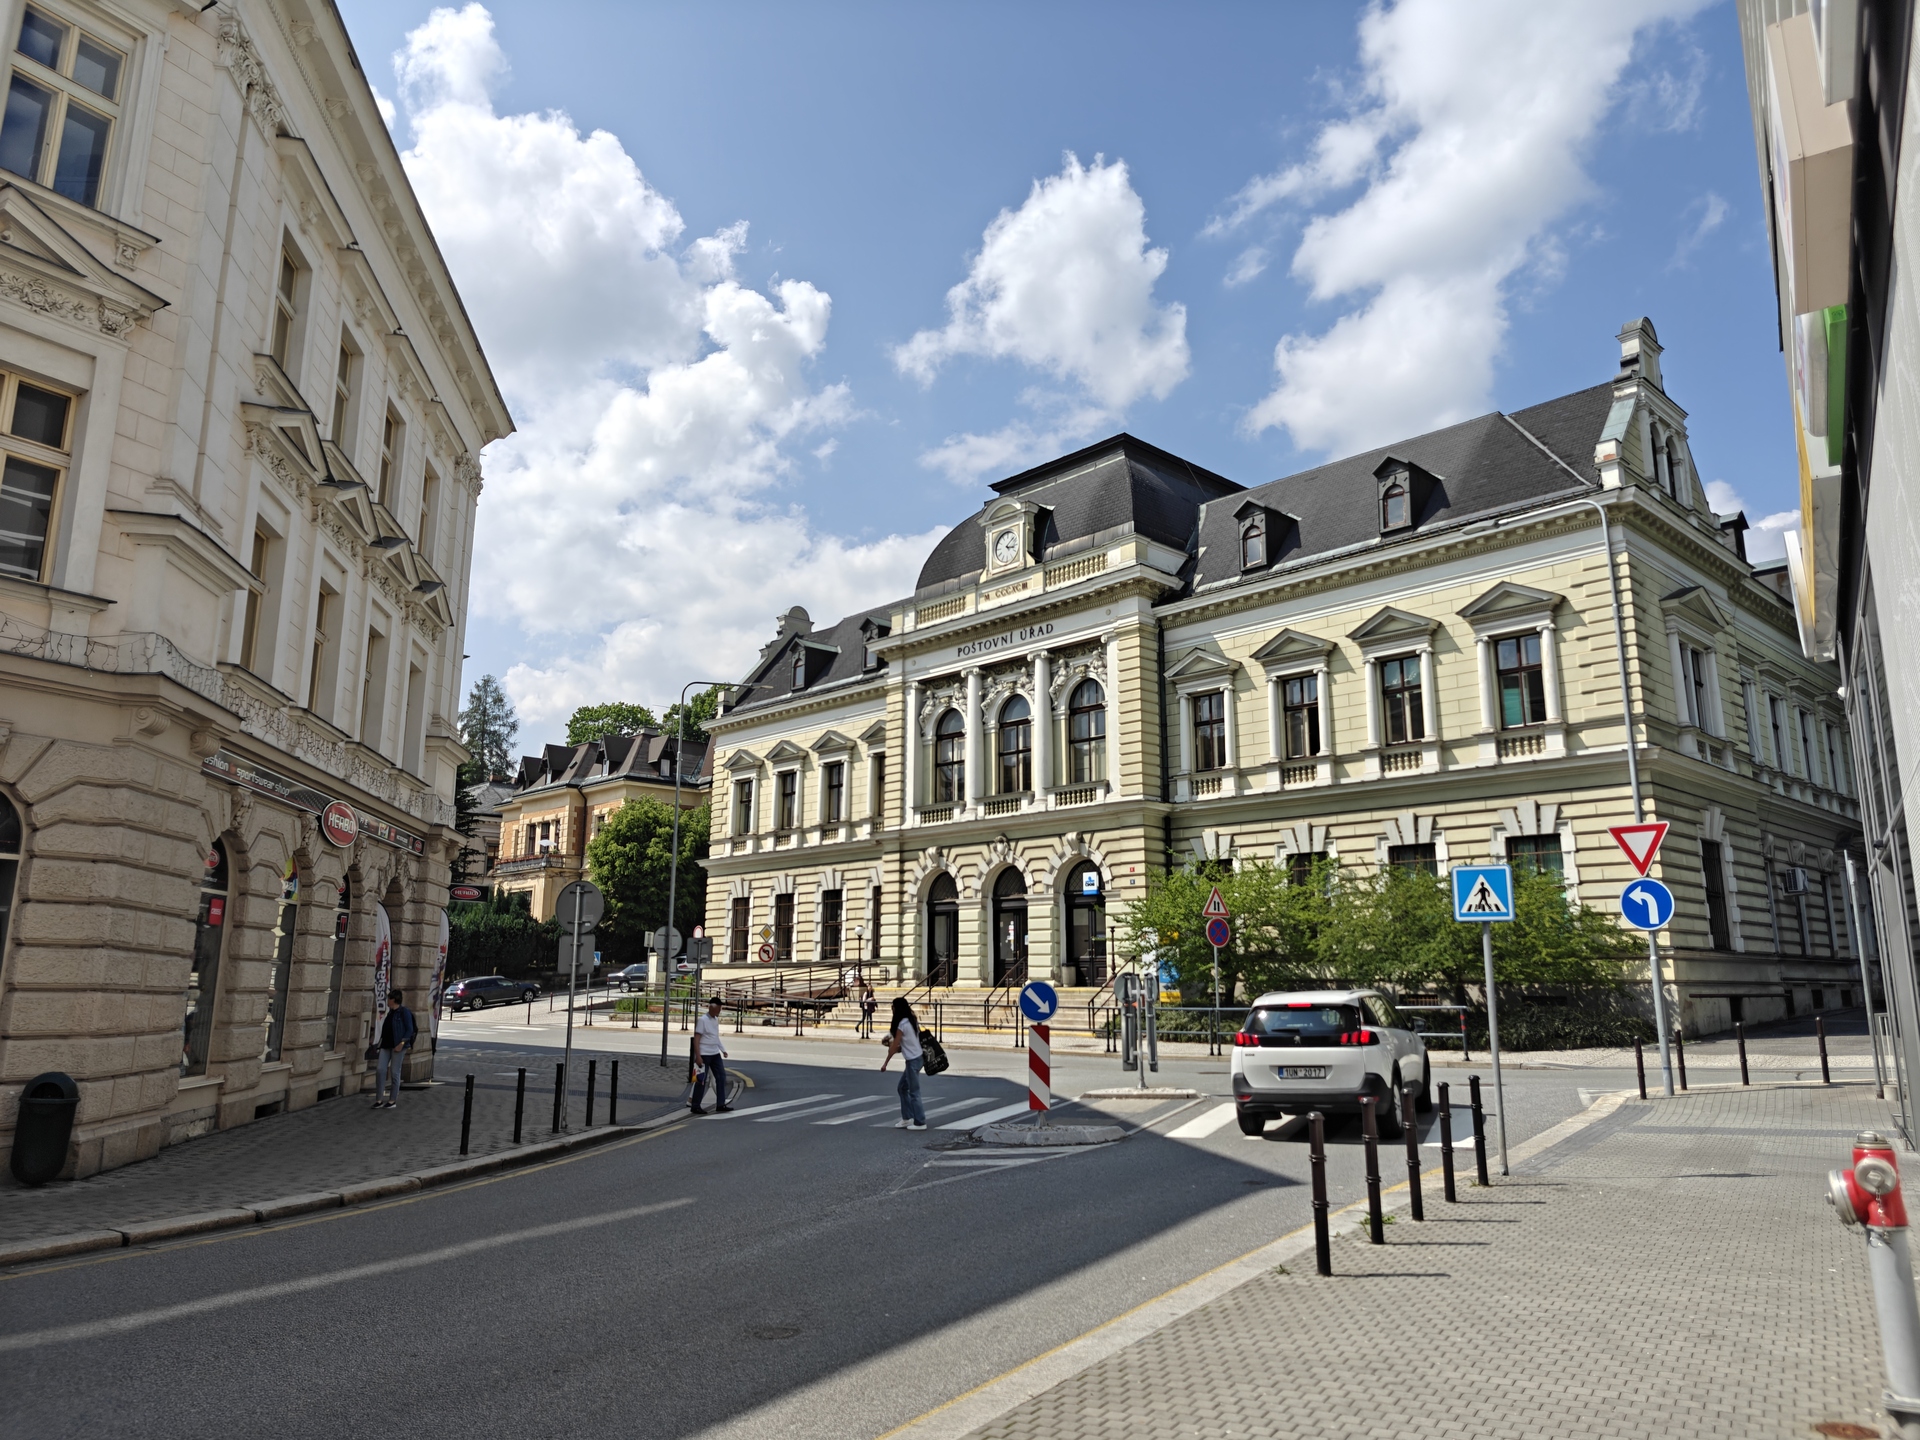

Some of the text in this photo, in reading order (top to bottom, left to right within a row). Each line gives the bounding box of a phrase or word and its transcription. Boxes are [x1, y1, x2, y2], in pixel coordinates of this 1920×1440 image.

[957, 623, 1053, 657] POŠTOVNÍ ÚŘAD
[203, 754, 229, 771] ashion
[236, 767, 274, 790] sportswear
[274, 782, 290, 798] shop
[1303, 1067, 1322, 1077] 2017
